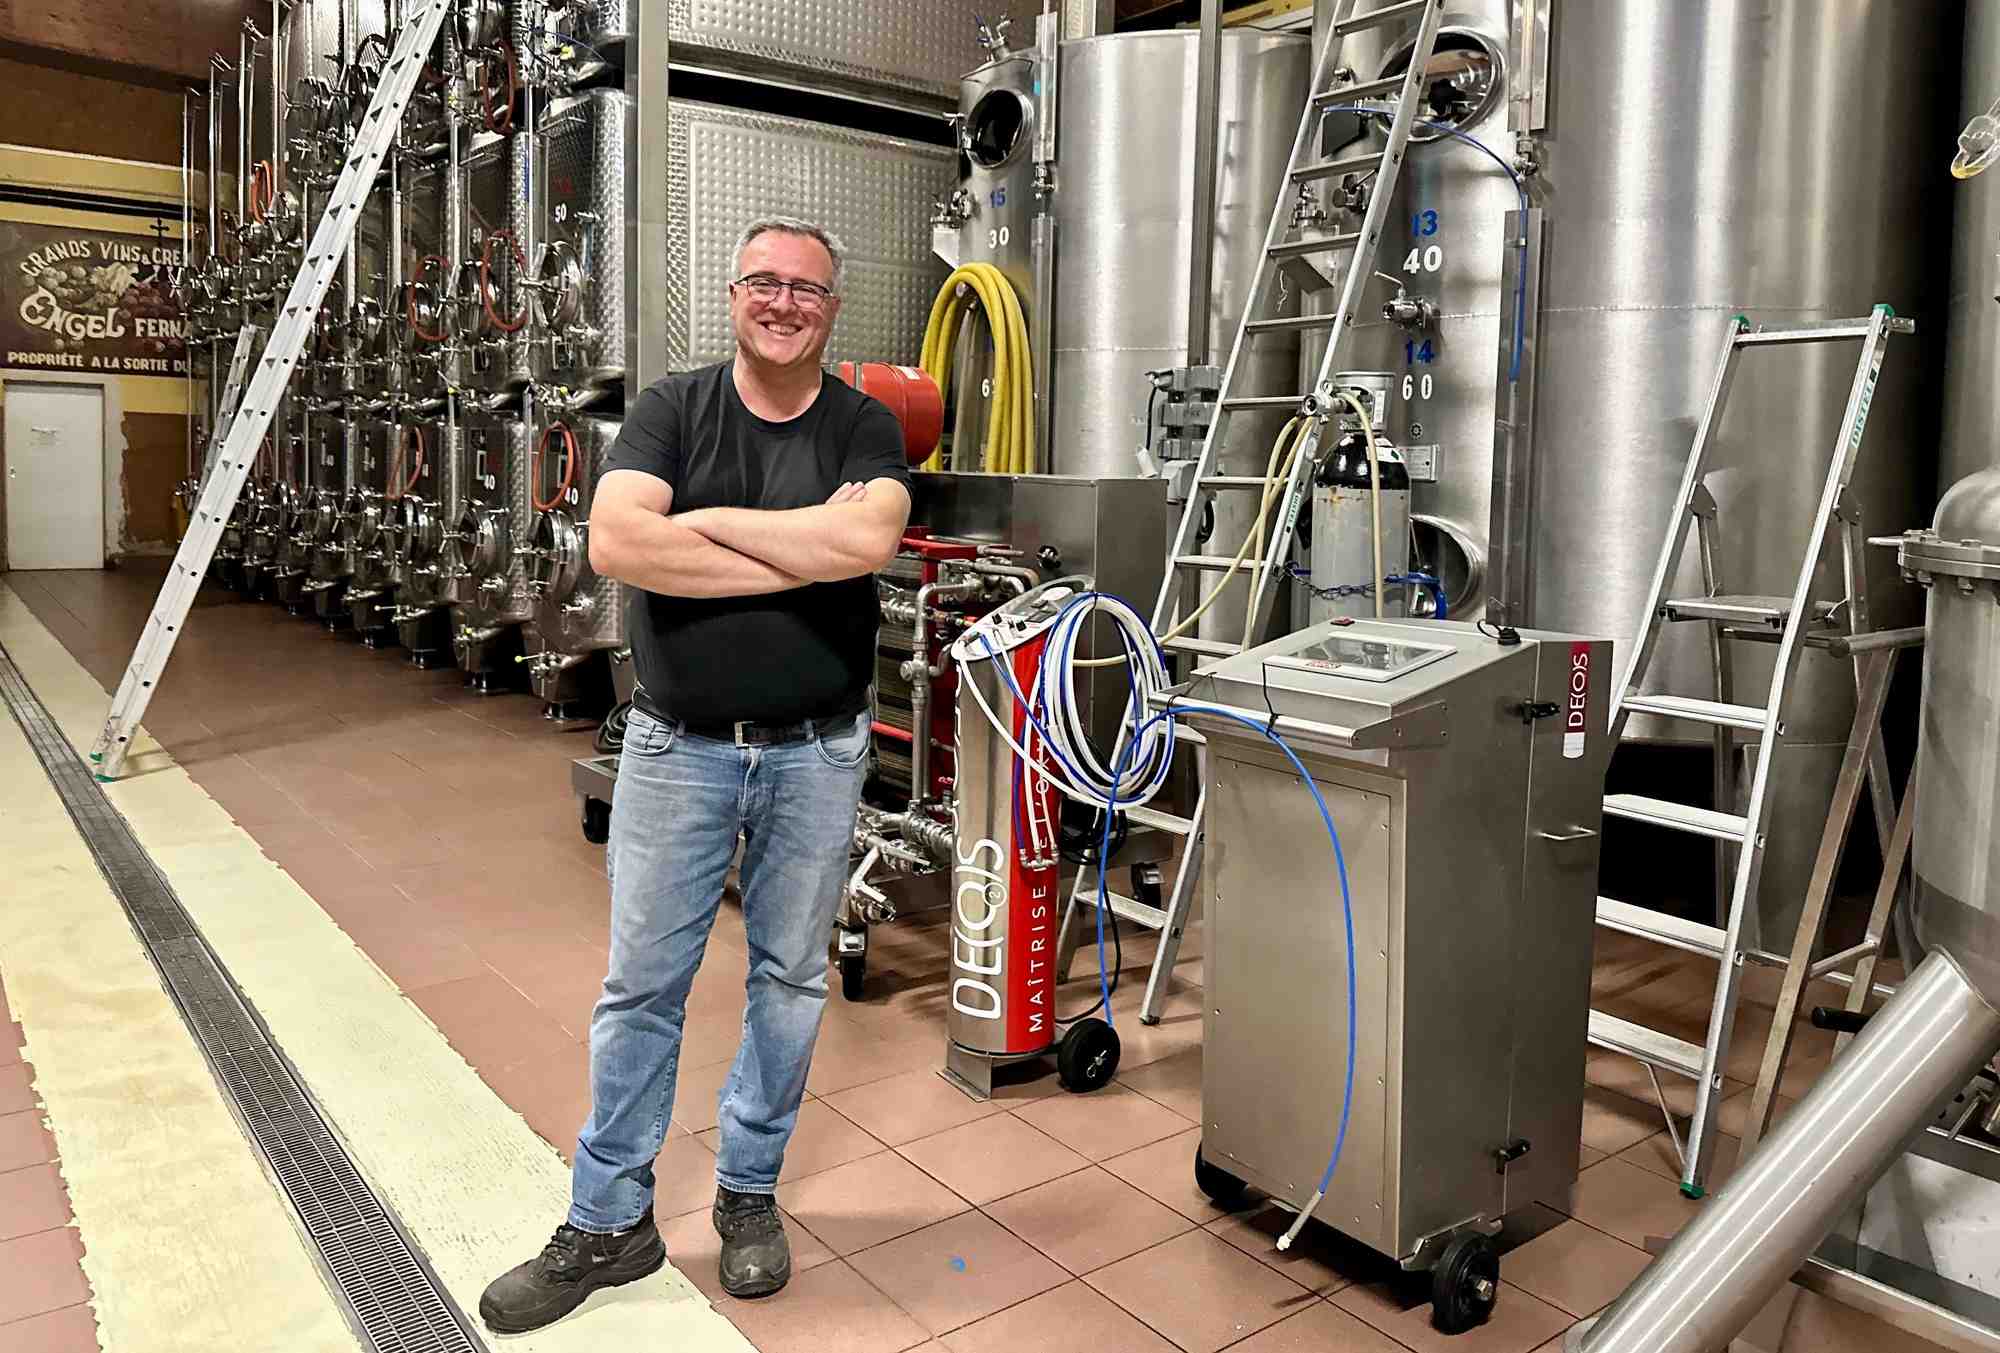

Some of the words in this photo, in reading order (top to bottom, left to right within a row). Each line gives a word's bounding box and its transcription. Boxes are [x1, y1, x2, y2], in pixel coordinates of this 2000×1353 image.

[554, 203, 567, 222] 50
[1411, 210, 1438, 236] 13
[989, 226, 1010, 249] 30
[20, 239, 91, 277] GRANDS
[100, 241, 141, 261] VINS
[1403, 245, 1442, 274] 40
[20, 285, 126, 340] ENGEL
[123, 358, 169, 371] SORTIE
[1406, 338, 1434, 365] 14
[1402, 374, 1433, 400] 60
[1027, 885, 1047, 1033] MAÎTRISE
